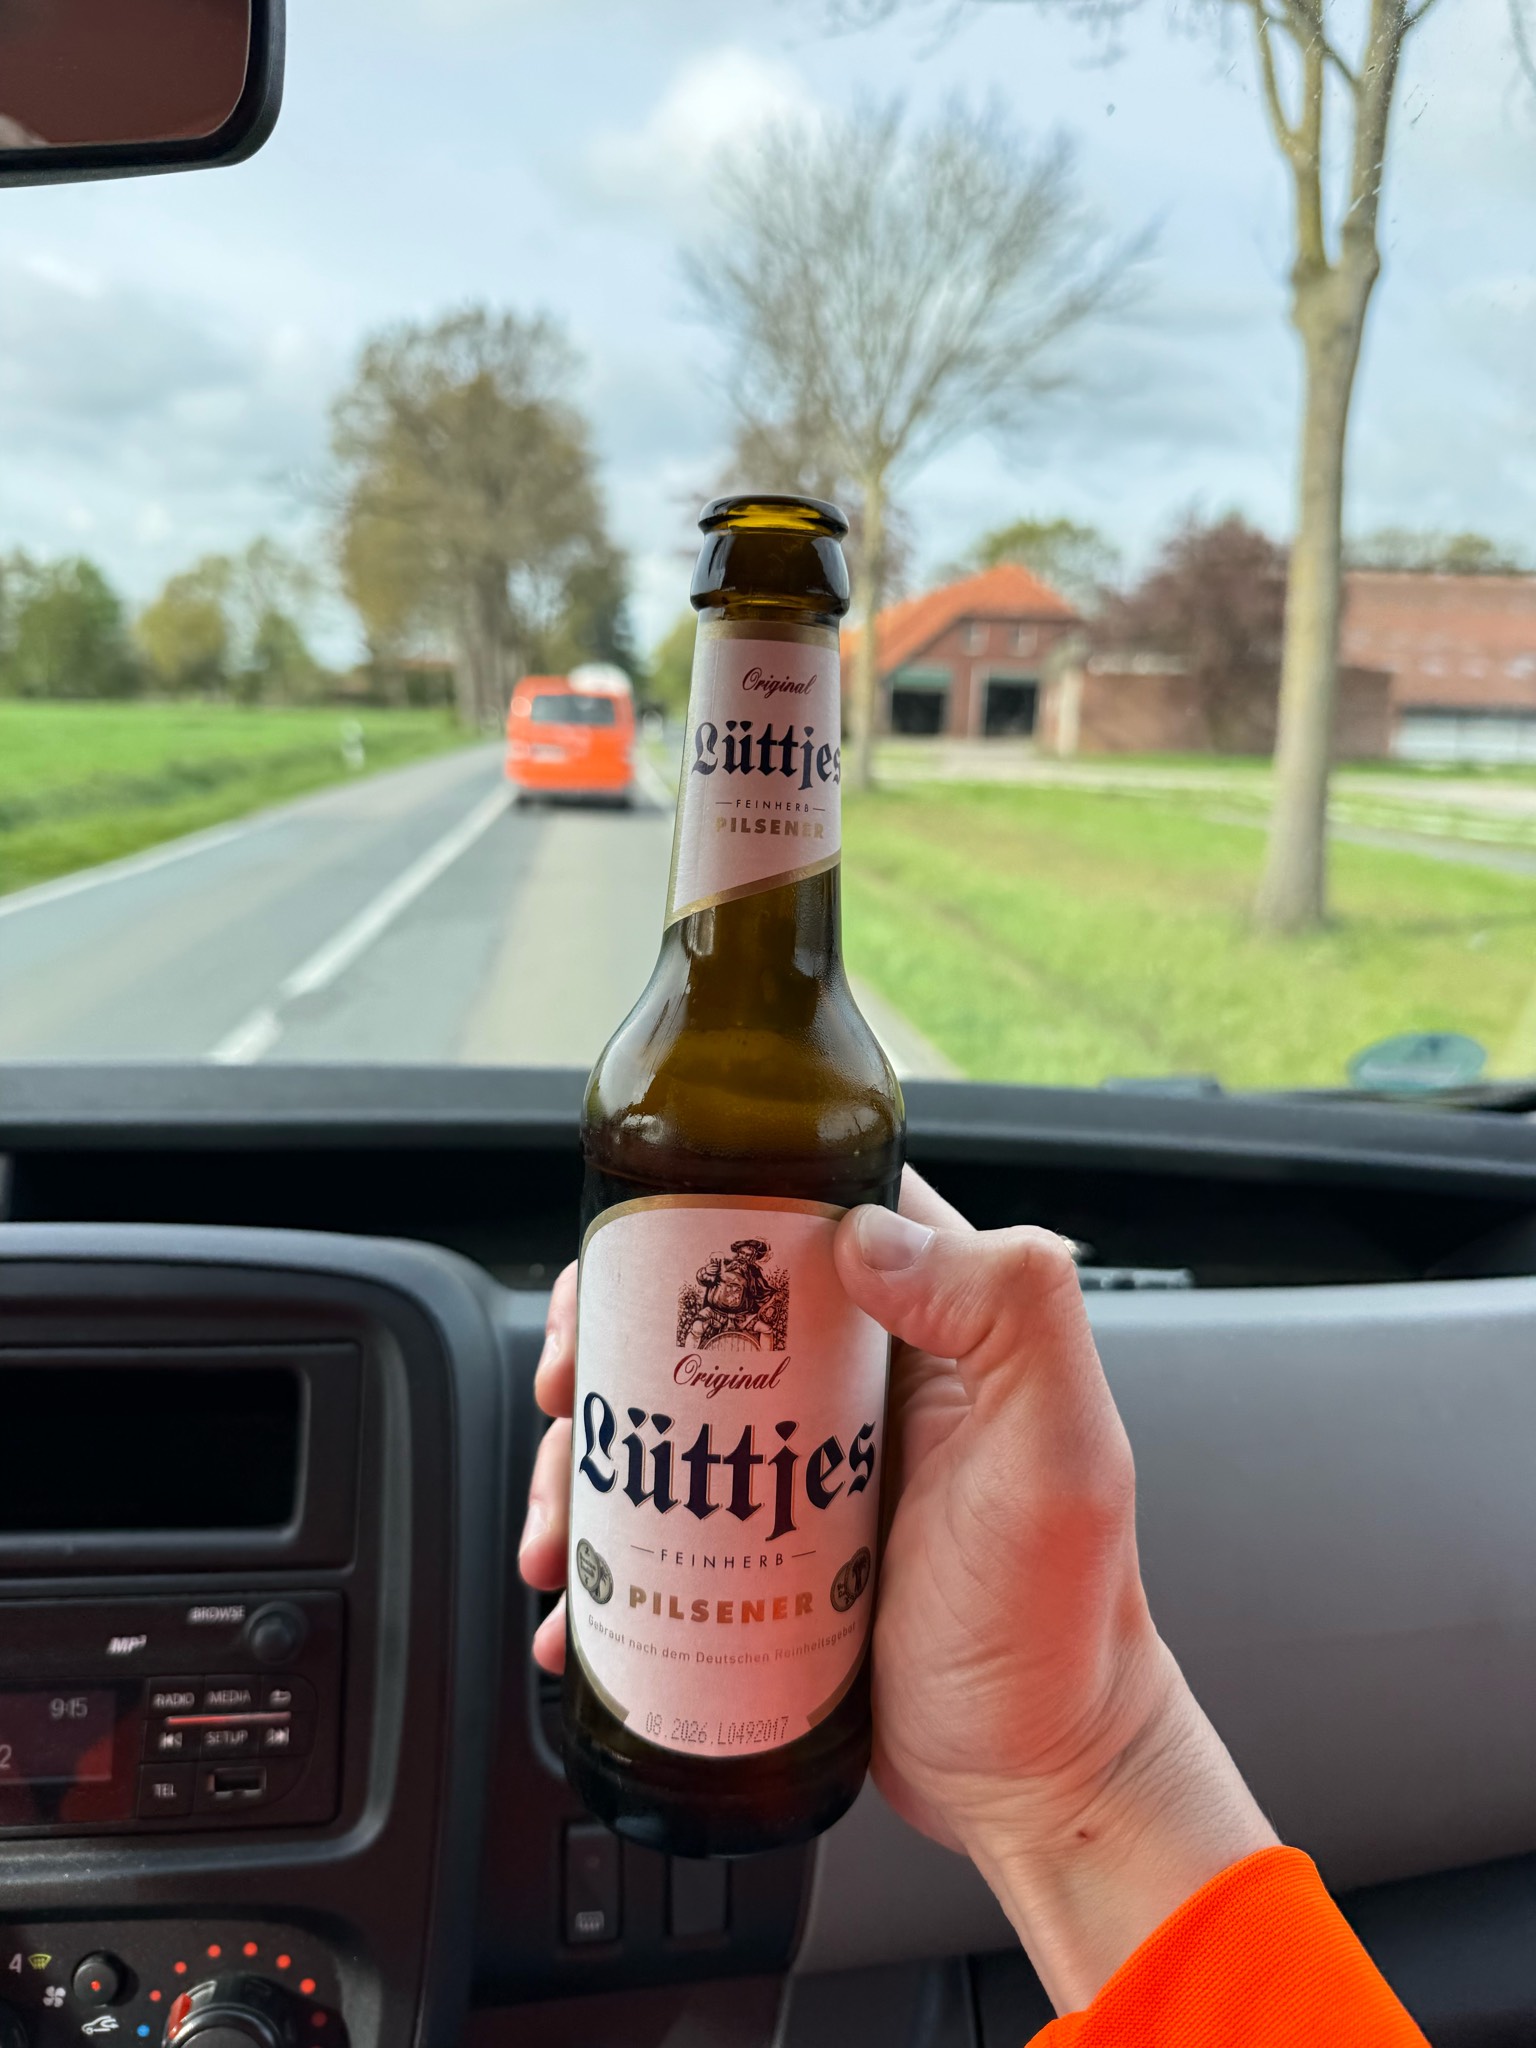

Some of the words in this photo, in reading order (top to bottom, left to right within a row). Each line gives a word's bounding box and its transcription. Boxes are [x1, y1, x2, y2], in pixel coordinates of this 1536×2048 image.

[742, 667, 818, 698] Original
[691, 720, 841, 791] Lüttjes
[736, 799, 809, 813] FEINHERB
[715, 816, 824, 839] PILSENER
[673, 1353, 791, 1399] Original
[579, 1391, 877, 1542] Lüttjes
[661, 1548, 784, 1569] FEINHERB
[629, 1584, 813, 1624] PILSENER
[588, 1614, 625, 1645] Gebraut
[629, 1638, 657, 1656] nach
[662, 1648, 690, 1662] dem
[696, 1651, 770, 1664] Deutschen
[775, 1621, 856, 1661] Reinheitsgebot
[153, 1691, 195, 1708] RADIO
[206, 1689, 251, 1705] MEDIA
[205, 1730, 249, 1746] SETUP
[153, 1782, 177, 1798] TEL
[8, 1953, 22, 1974] 4
